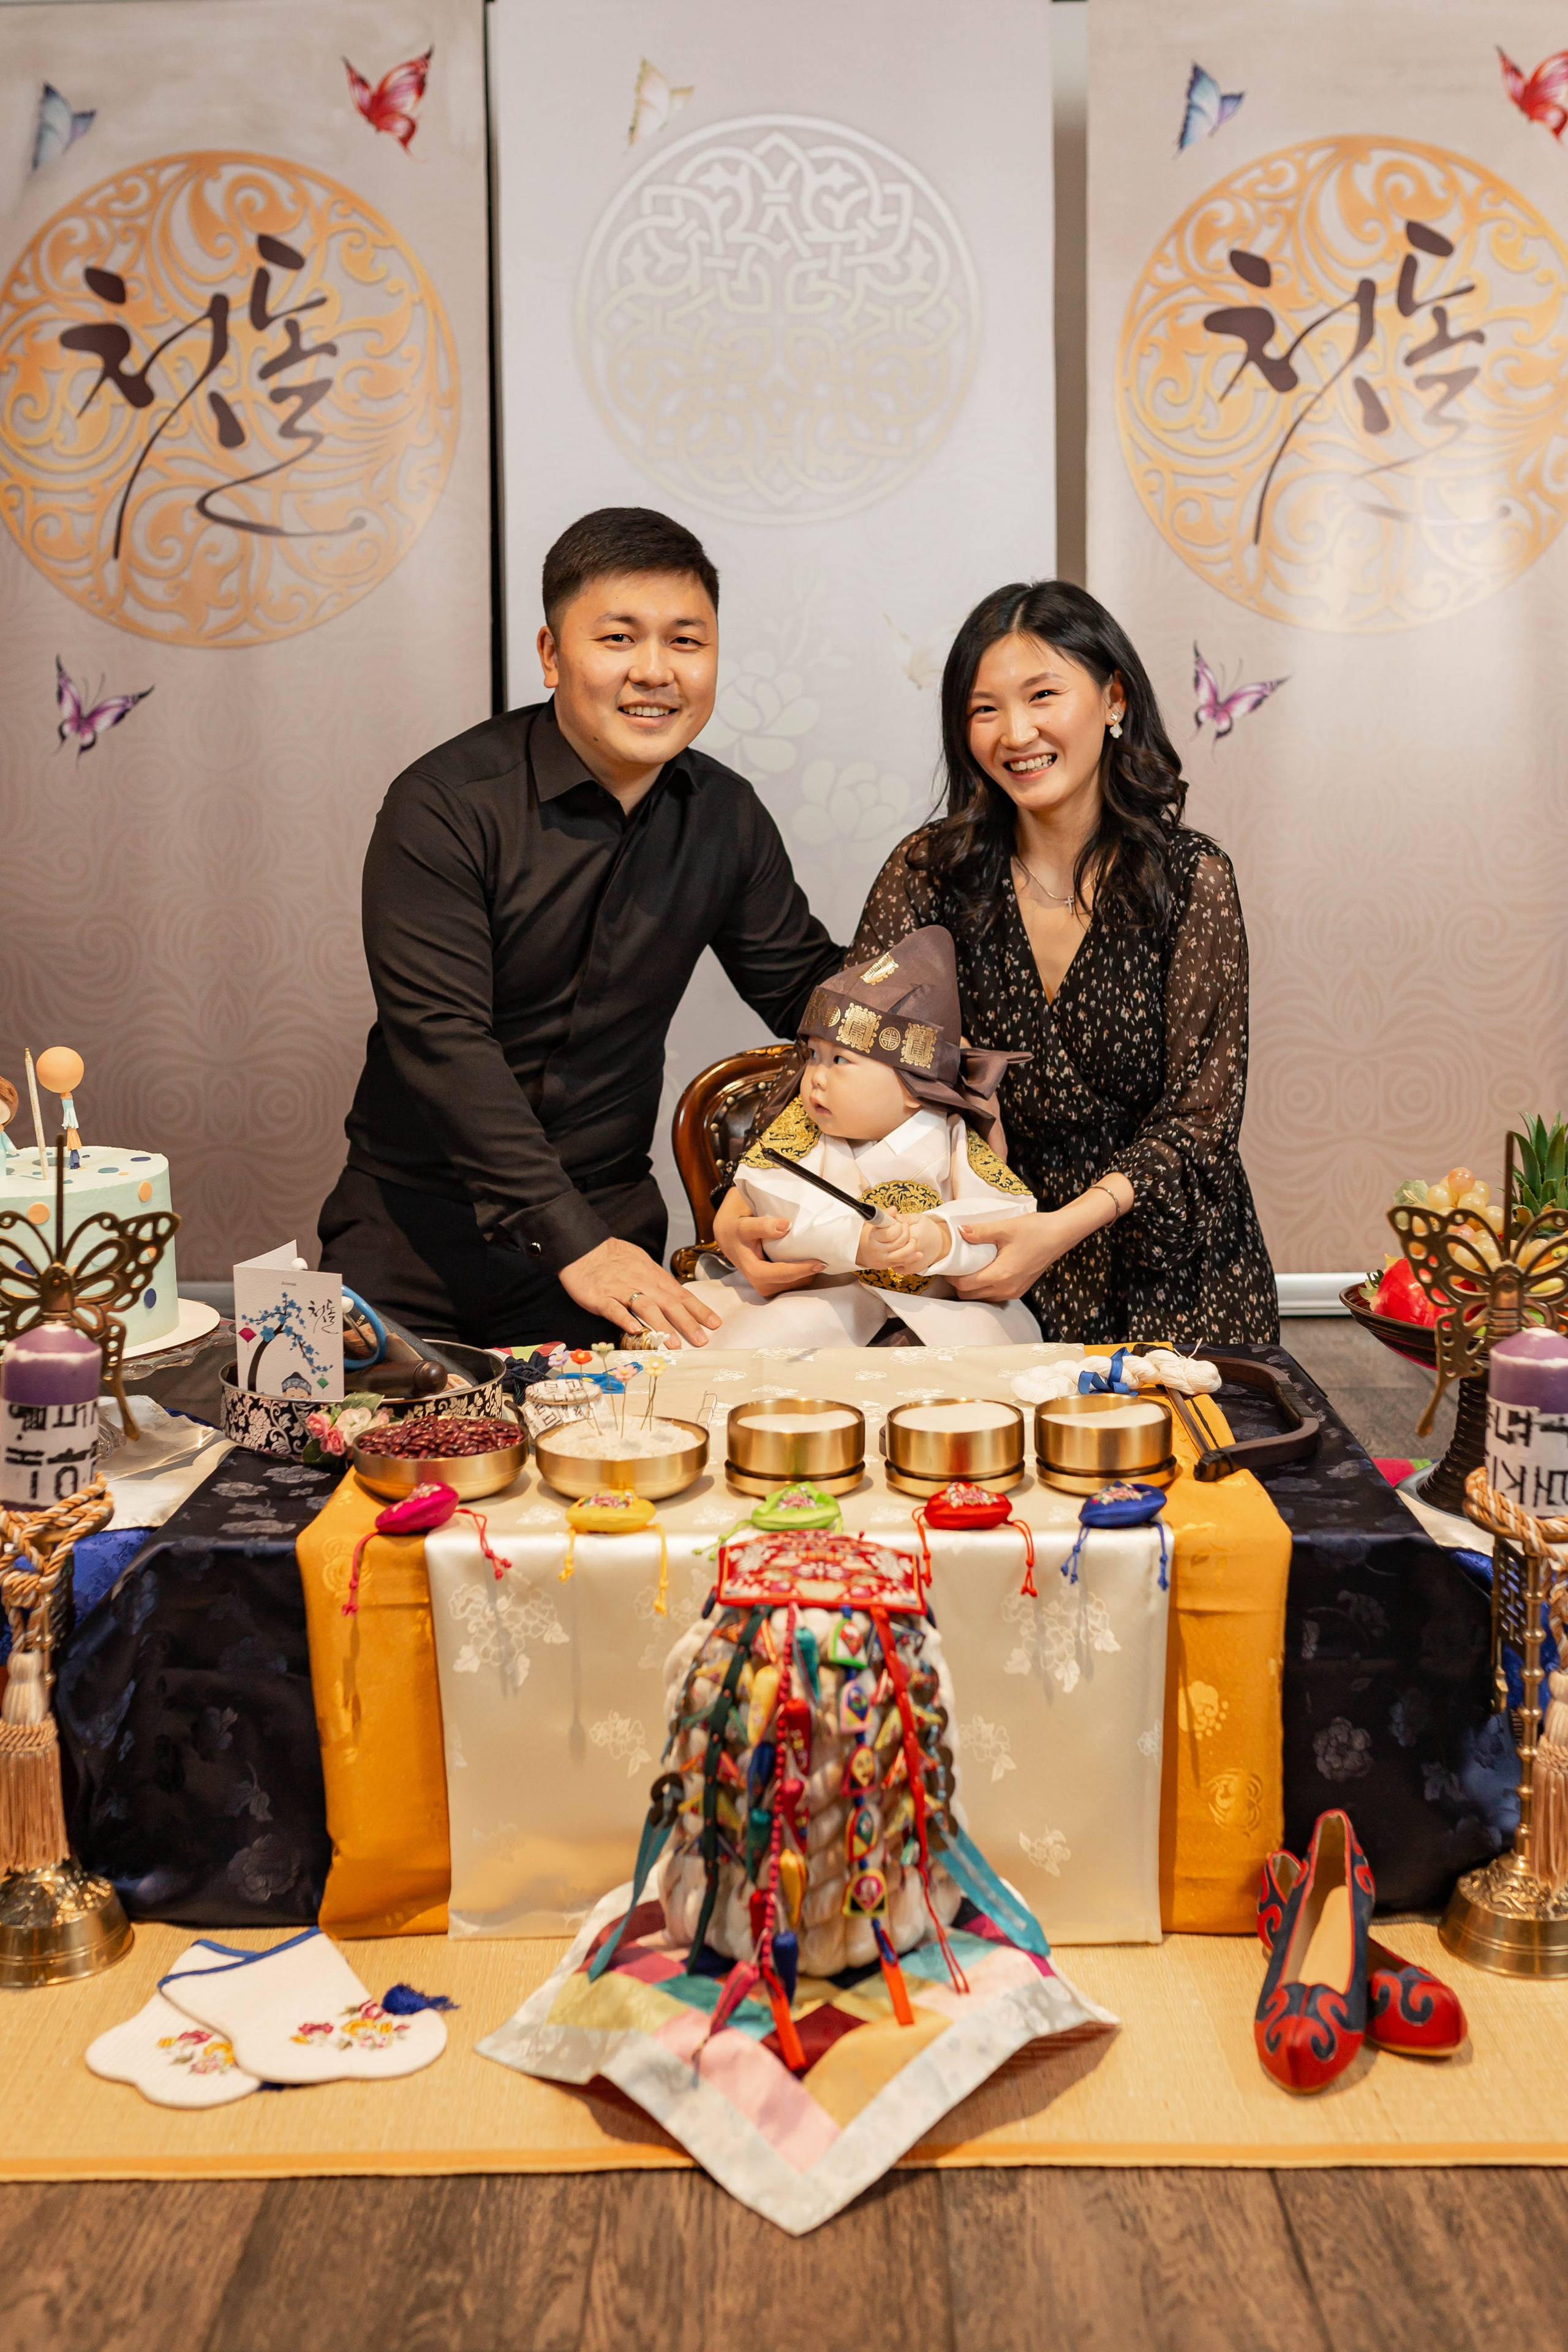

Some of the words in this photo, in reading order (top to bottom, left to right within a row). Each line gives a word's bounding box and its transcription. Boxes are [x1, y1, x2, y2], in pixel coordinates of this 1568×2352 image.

[60, 233, 366, 559] 첫돌
[1204, 221, 1511, 545] 첫돌
[308, 1298, 339, 1334] 첫돌
